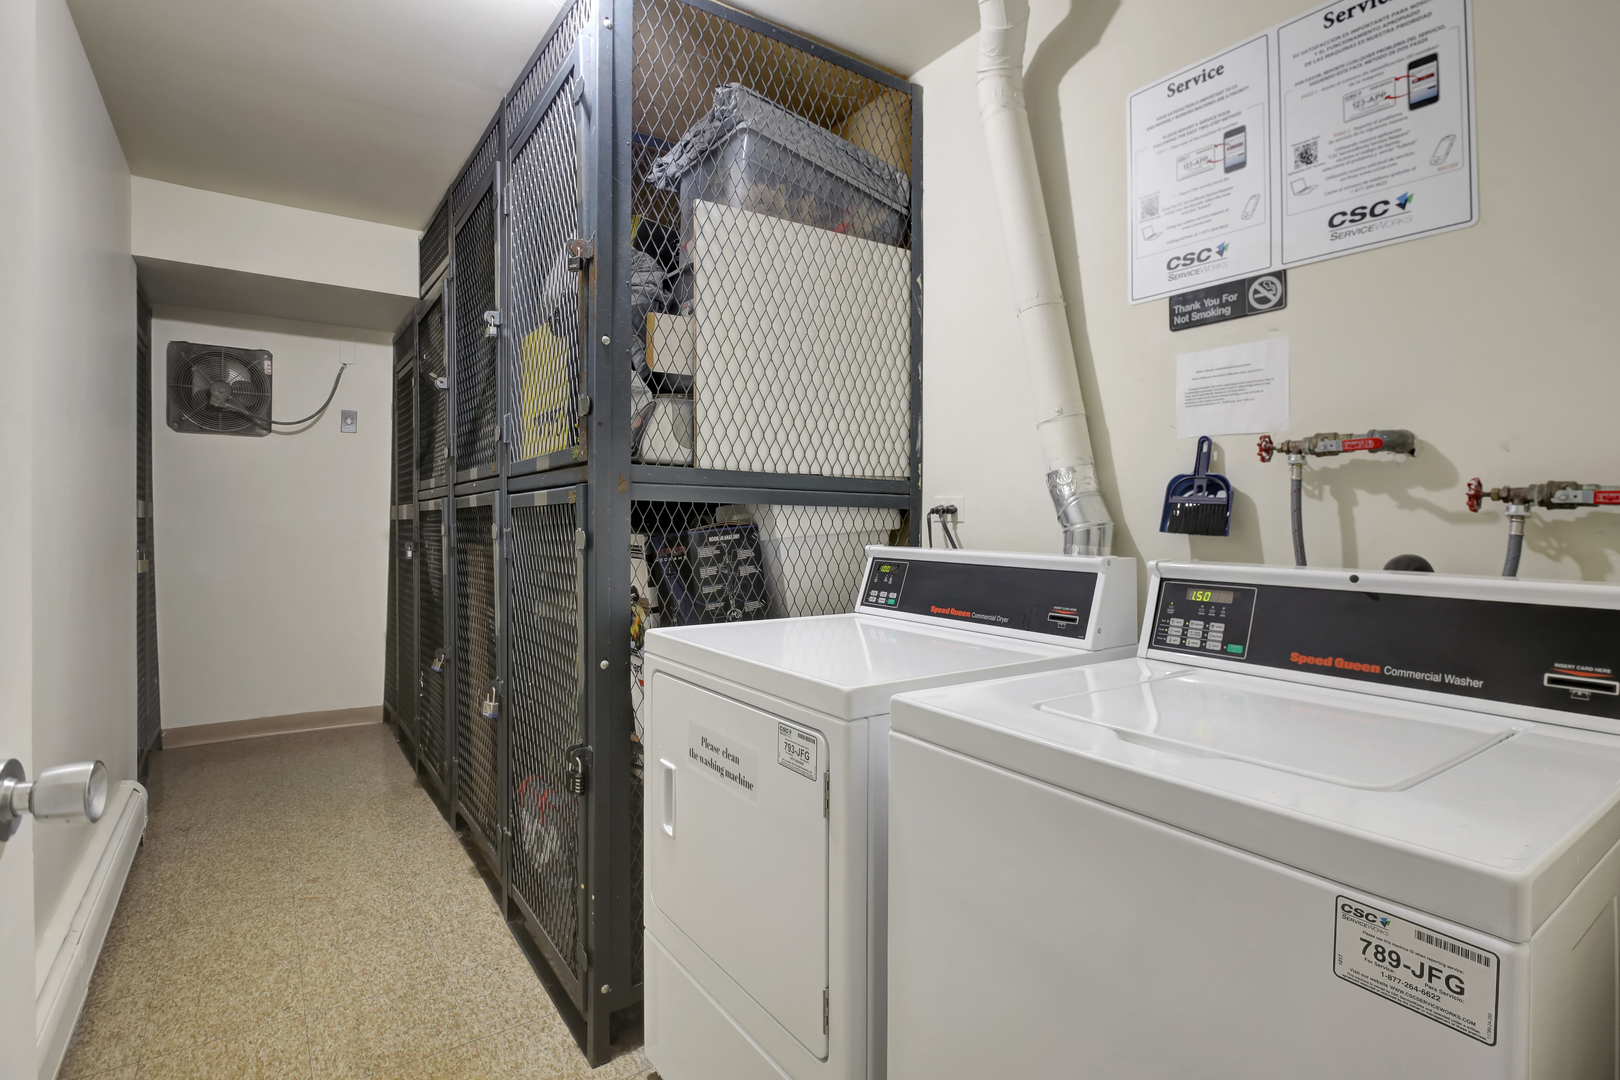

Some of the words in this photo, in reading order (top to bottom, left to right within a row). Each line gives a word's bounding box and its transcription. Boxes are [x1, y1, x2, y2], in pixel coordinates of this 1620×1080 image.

[1166, 64, 1224, 98] Service
[1352, 91, 1386, 108] 123-APP
[1327, 198, 1390, 229] CSC
[1166, 246, 1212, 271] CSC
[1174, 301, 1200, 314] Thank
[1203, 298, 1219, 307] You
[1223, 293, 1238, 303] For
[1174, 315, 1189, 325] Not
[1191, 306, 1231, 321] Smoking
[930, 605, 950, 614] Speed
[950, 608, 971, 617] Queen
[972, 612, 996, 621] Commercial
[1290, 652, 1333, 667] Speed
[1335, 657, 1381, 674] Queen
[1384, 666, 1442, 682] Commercial
[1445, 673, 1484, 688] Washer
[701, 736, 720, 755] Please
[722, 747, 740, 765] clean
[784, 741, 809, 761] 793-JFG
[689, 748, 699, 759] the
[700, 755, 725, 778] washing
[725, 770, 754, 791] machine
[1341, 903, 1377, 923] CSC
[1392, 942, 1408, 952] machine
[1426, 956, 1445, 967] reporting
[1349, 967, 1359, 976] Visit
[1359, 936, 1465, 997] 789-JFG
[1374, 961, 1395, 974] Service:
[1380, 971, 1440, 1002] 1-877-264-6622
[1424, 982, 1437, 992] Para
[1439, 988, 1464, 1004] Servicio:
